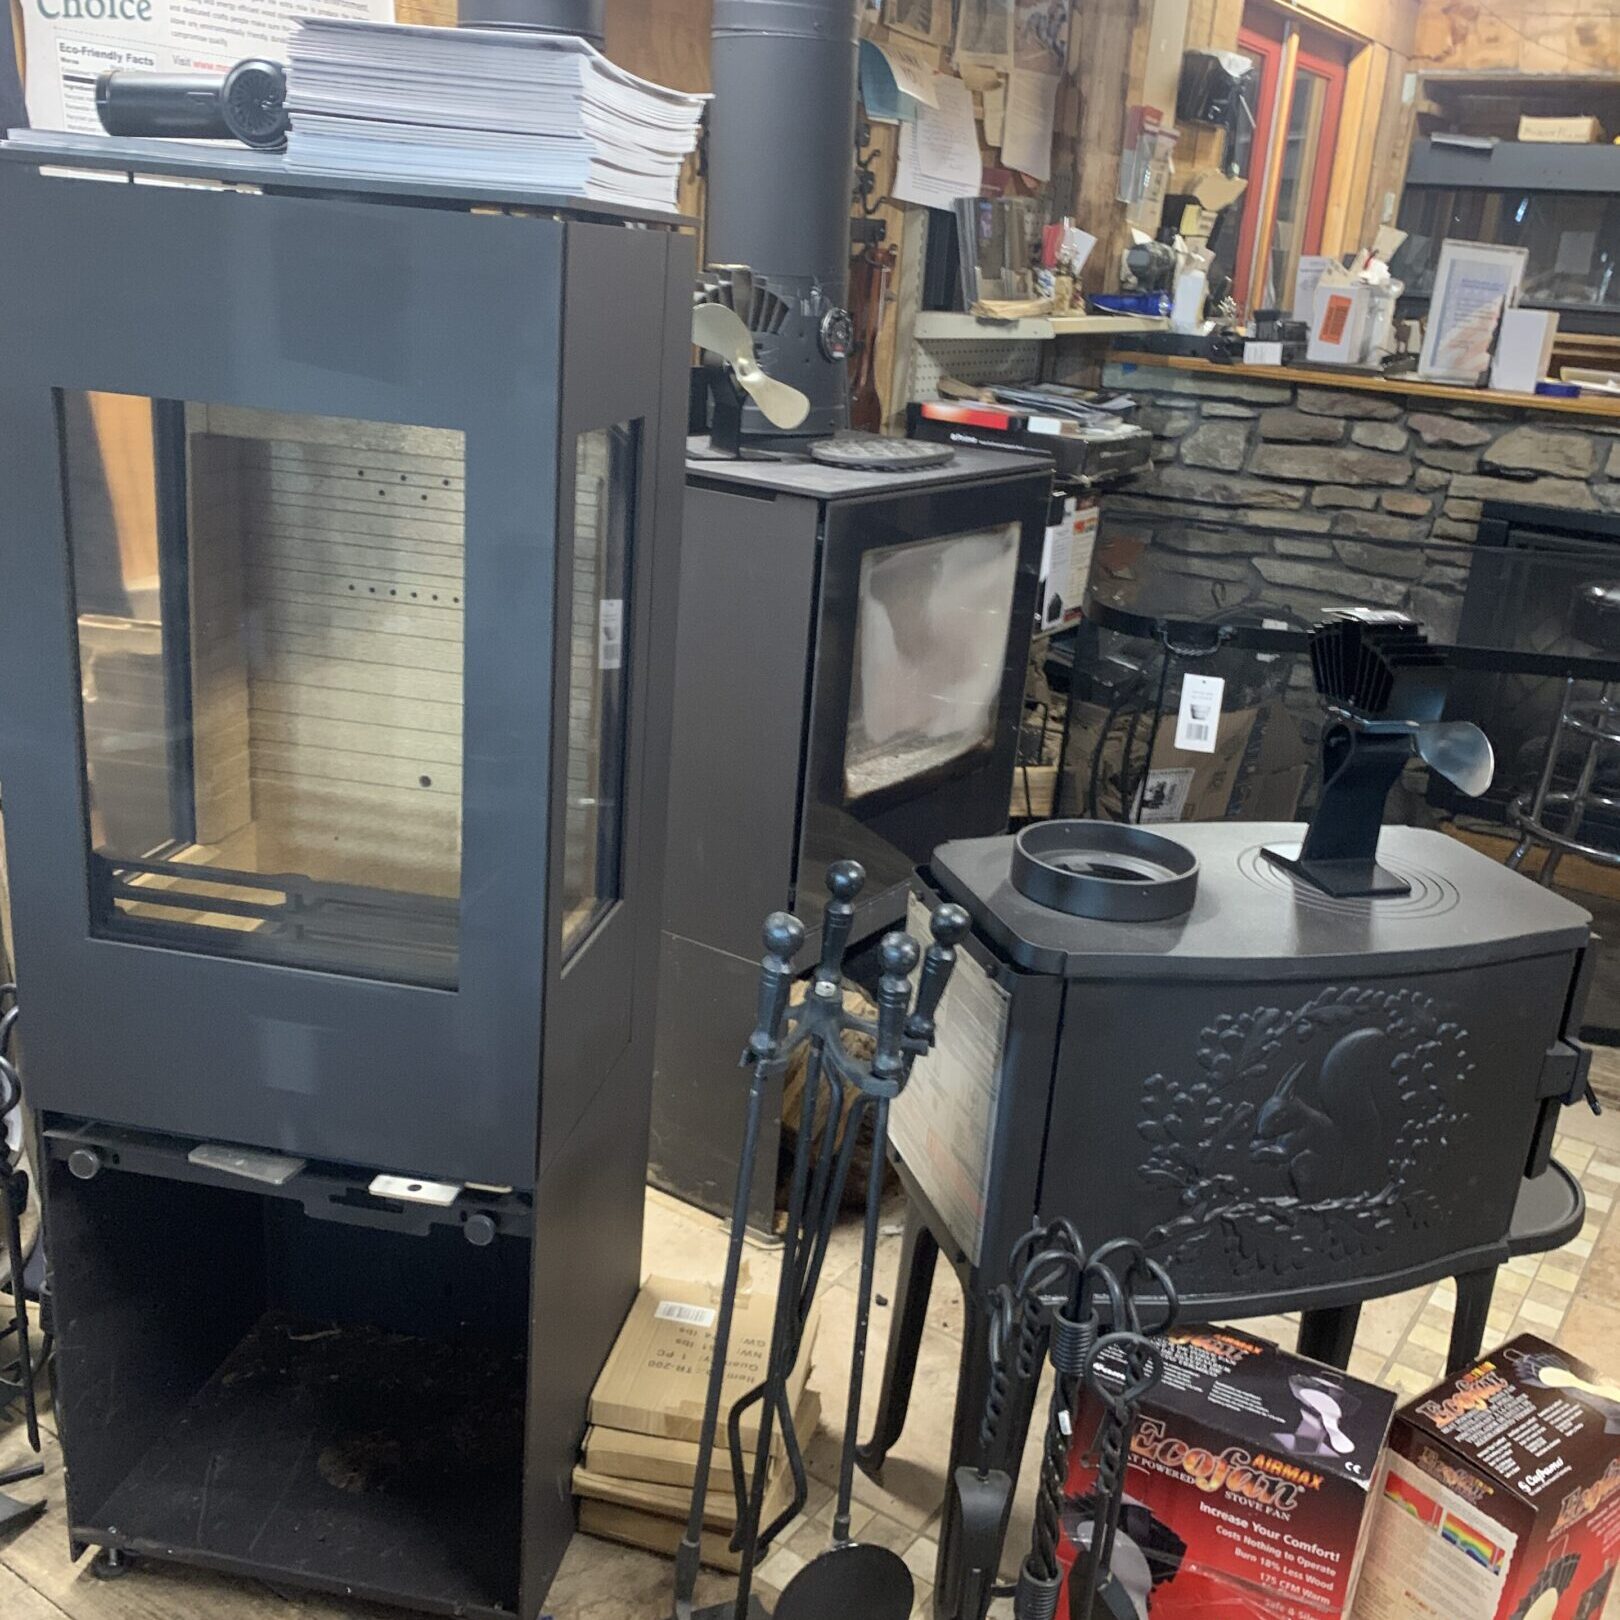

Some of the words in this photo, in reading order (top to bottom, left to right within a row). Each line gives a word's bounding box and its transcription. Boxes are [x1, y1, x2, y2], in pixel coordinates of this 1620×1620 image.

[38, 0, 152, 21] Choice
[59, 42, 123, 63] Eco-Friendly
[126, 53, 154, 66] Facts
[1130, 1414, 1299, 1511] Ecofan
[1141, 1458, 1196, 1485] POWERED
[1252, 1454, 1325, 1490] AIRMAX
[1225, 1490, 1263, 1511] STOVE
[1265, 1506, 1291, 1521] FAN
[1200, 1501, 1249, 1529] Increase
[1252, 1521, 1281, 1540] Your
[1283, 1534, 1341, 1562] Comfort!
[1216, 1524, 1242, 1541] Costs
[1243, 1535, 1282, 1558] Nothing
[1284, 1551, 1295, 1562] to
[1297, 1556, 1336, 1577] Operate
[1234, 1547, 1257, 1562] Burn
[1260, 1557, 1281, 1572] 18%
[1283, 1566, 1304, 1580] Less
[1305, 1574, 1335, 1591] Wood
[1279, 1580, 1301, 1594] CFM
[1302, 1588, 1331, 1606] Warm
